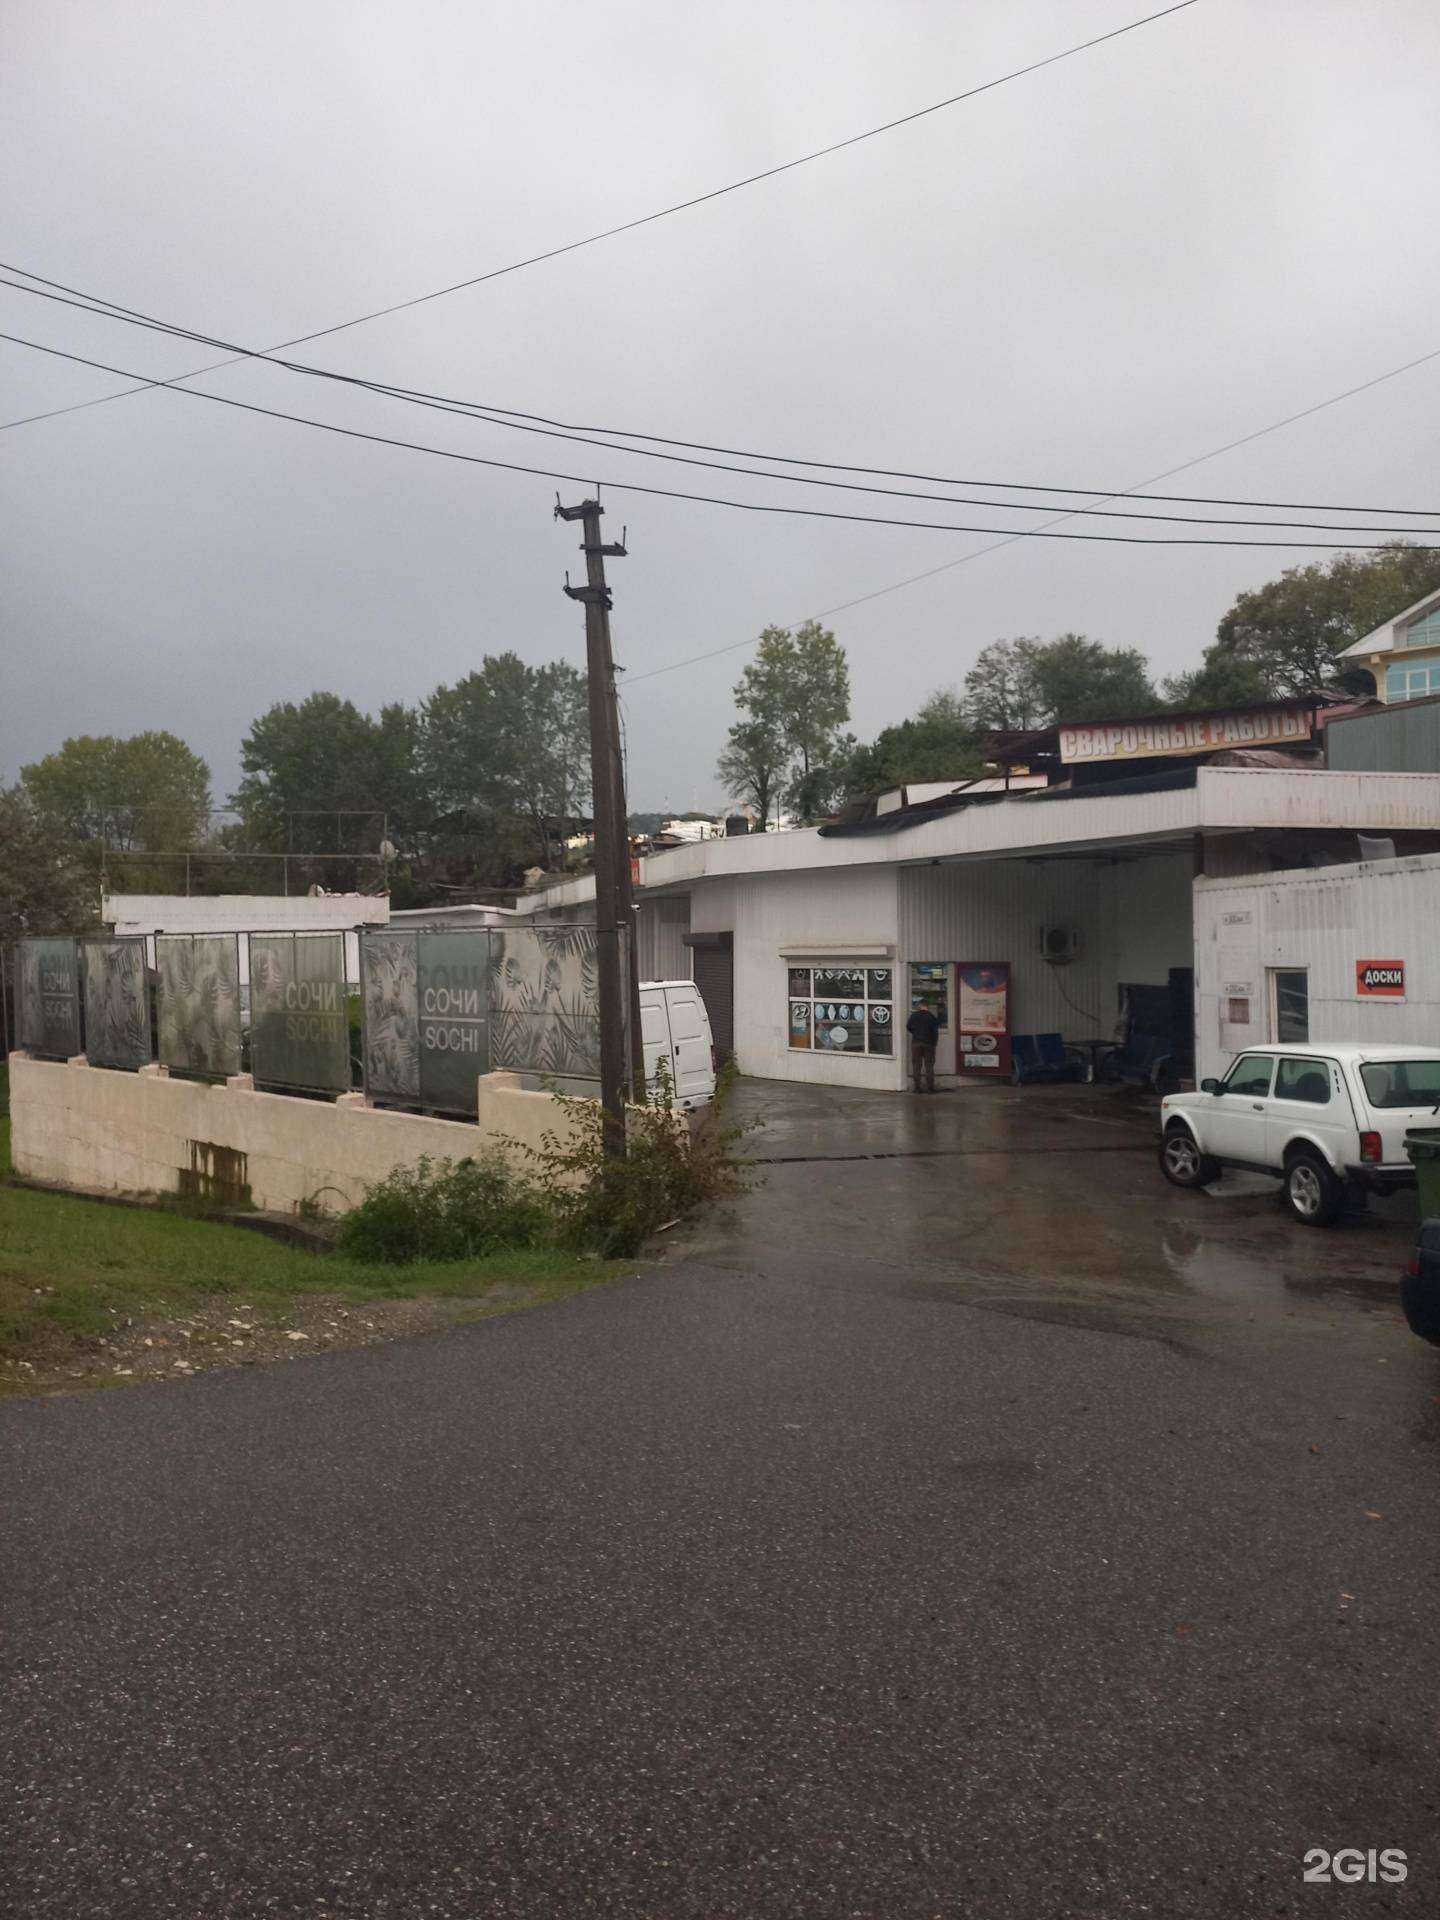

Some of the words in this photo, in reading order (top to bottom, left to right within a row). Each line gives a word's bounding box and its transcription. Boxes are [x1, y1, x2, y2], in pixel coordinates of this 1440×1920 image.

[1060, 722, 1205, 758] СВАРОЧНЫЕ
[1209, 710, 1305, 743] РАБОТЫ
[1365, 970, 1402, 985] ДОСКИ
[286, 982, 337, 1011] СОЧИ
[424, 987, 478, 1014] СОЧИ
[286, 1016, 338, 1042] SOCHI
[425, 1026, 478, 1052] SOCHI
